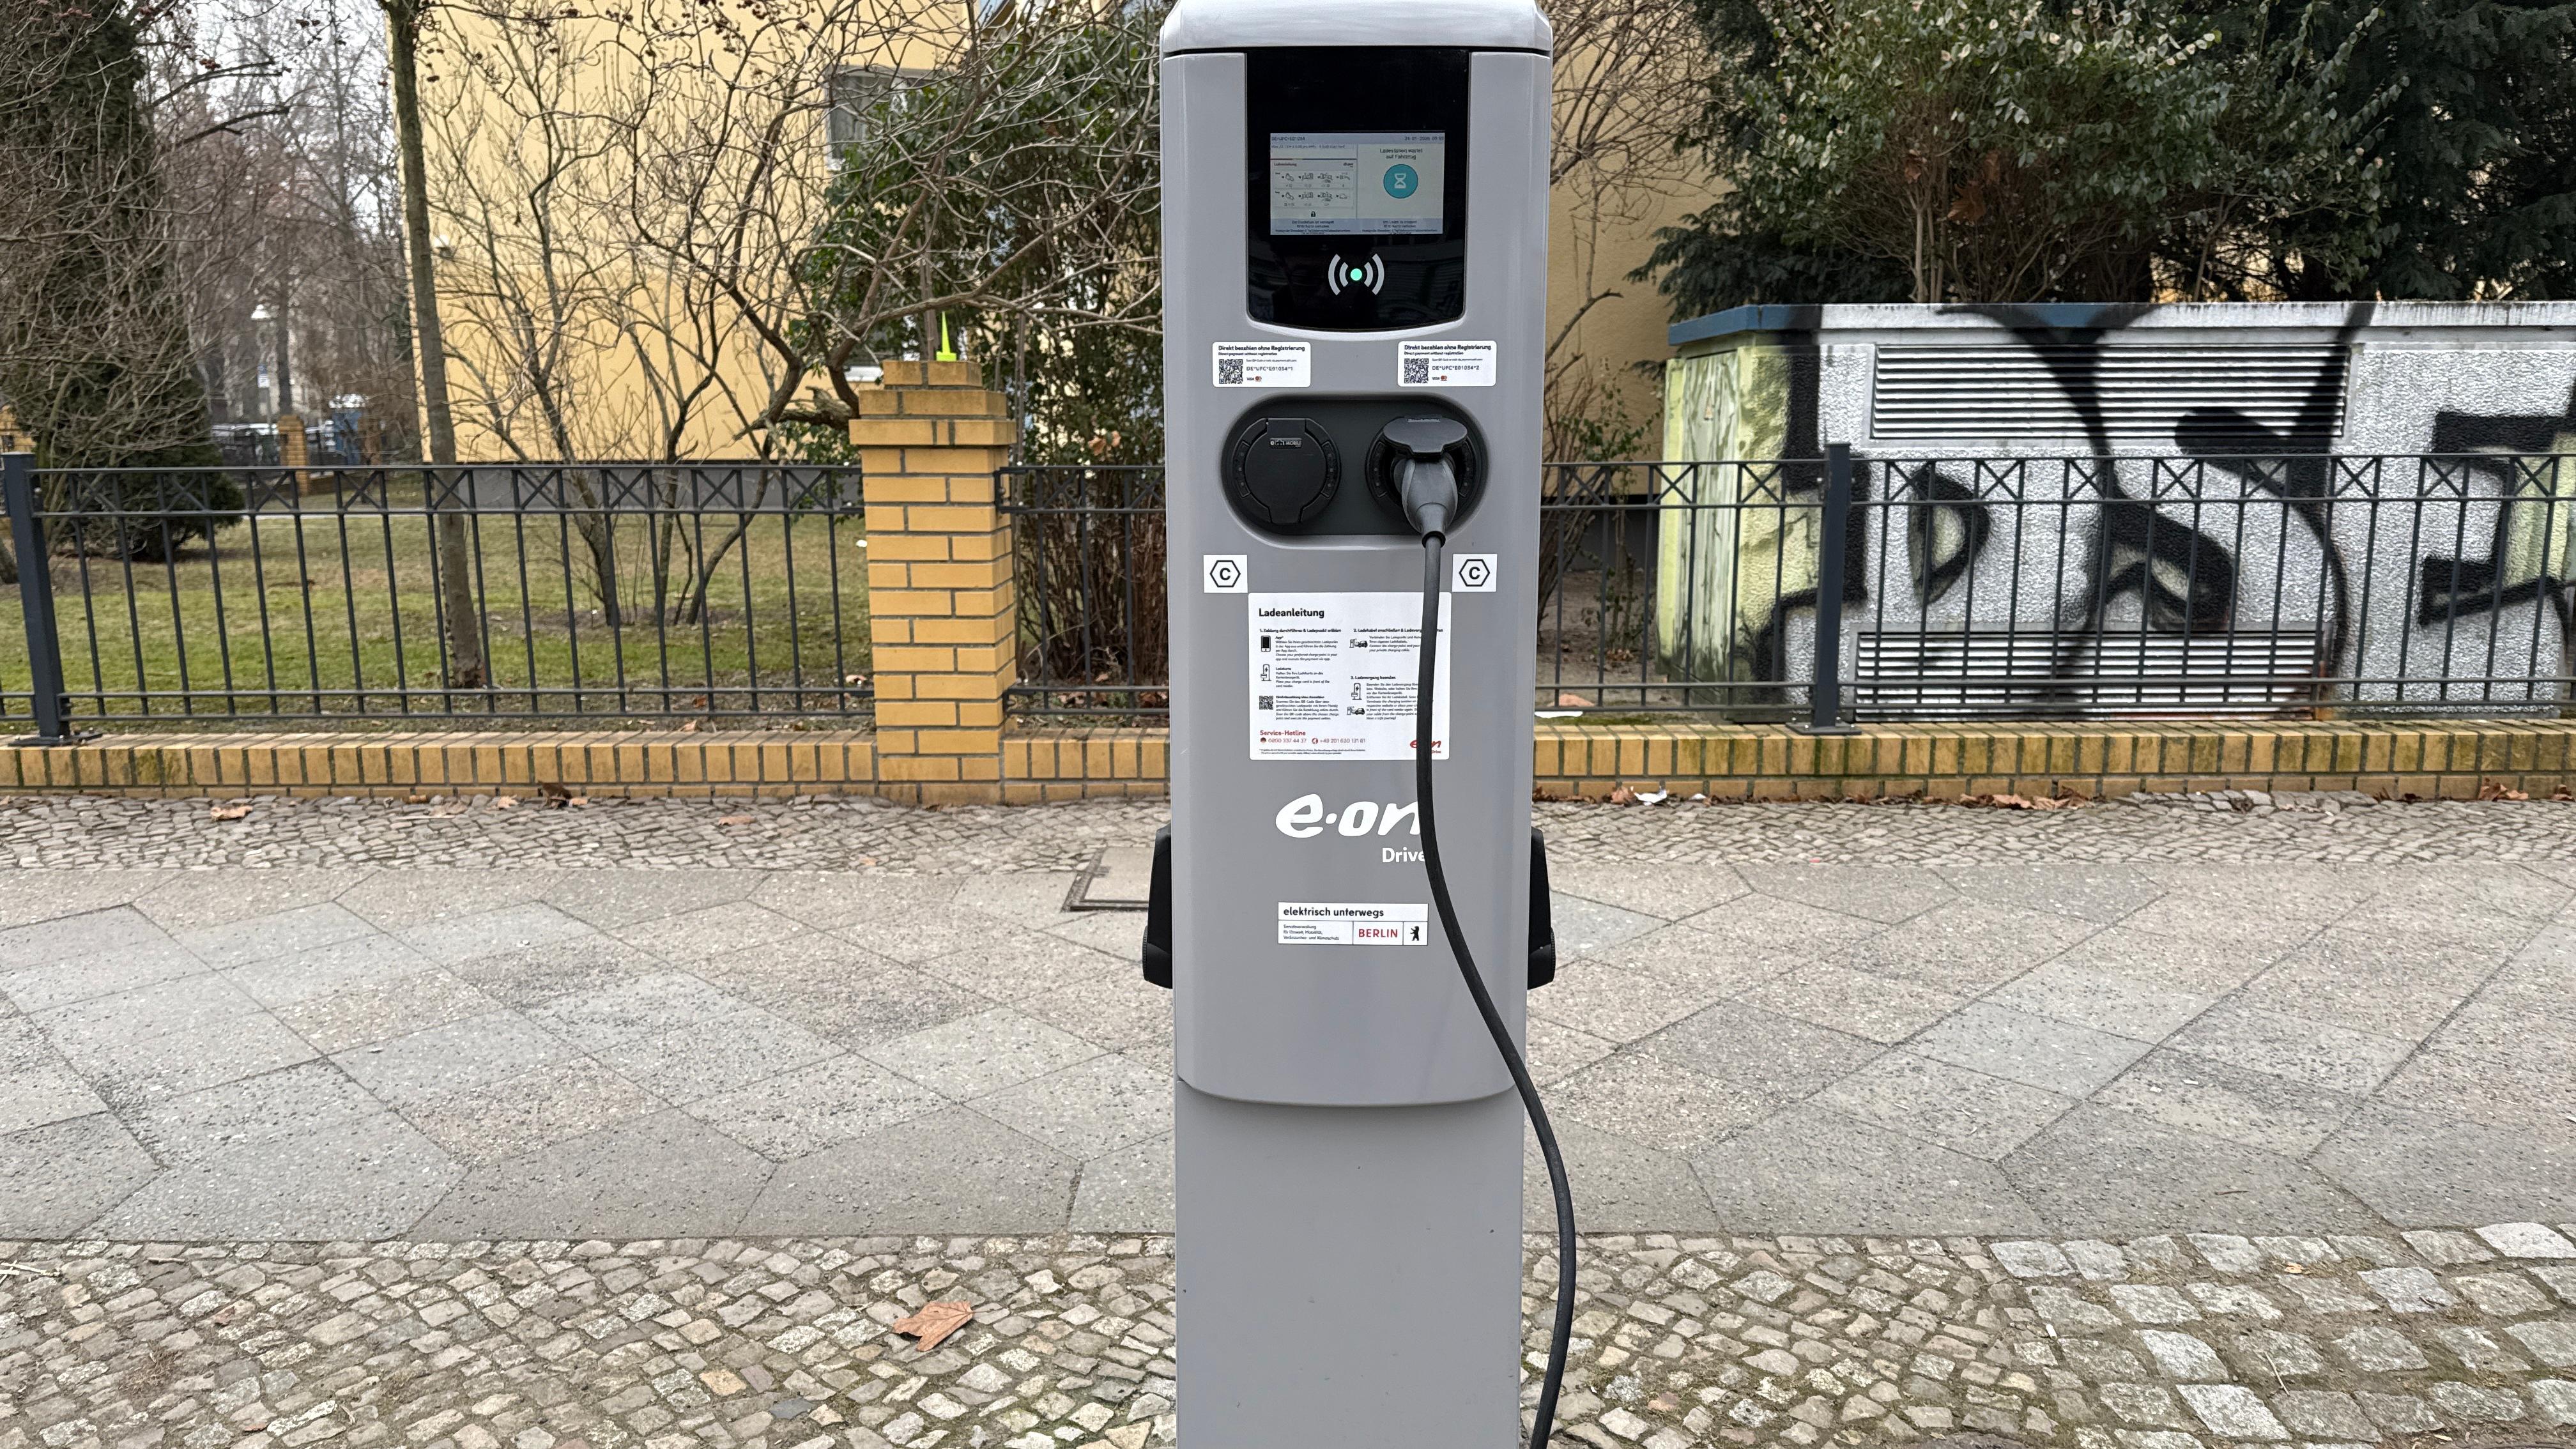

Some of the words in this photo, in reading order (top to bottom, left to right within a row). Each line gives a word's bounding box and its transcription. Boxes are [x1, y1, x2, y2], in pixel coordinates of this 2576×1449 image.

[1219, 568, 1231, 580] C
[1469, 567, 1480, 579] C
[1259, 608, 1324, 618] Ladeanleitung
[1382, 847, 1425, 862] Drive
[1283, 907, 1331, 916] elektrisch
[1334, 908, 1384, 919] unterwegs
[1358, 928, 1398, 938] BERLIN
